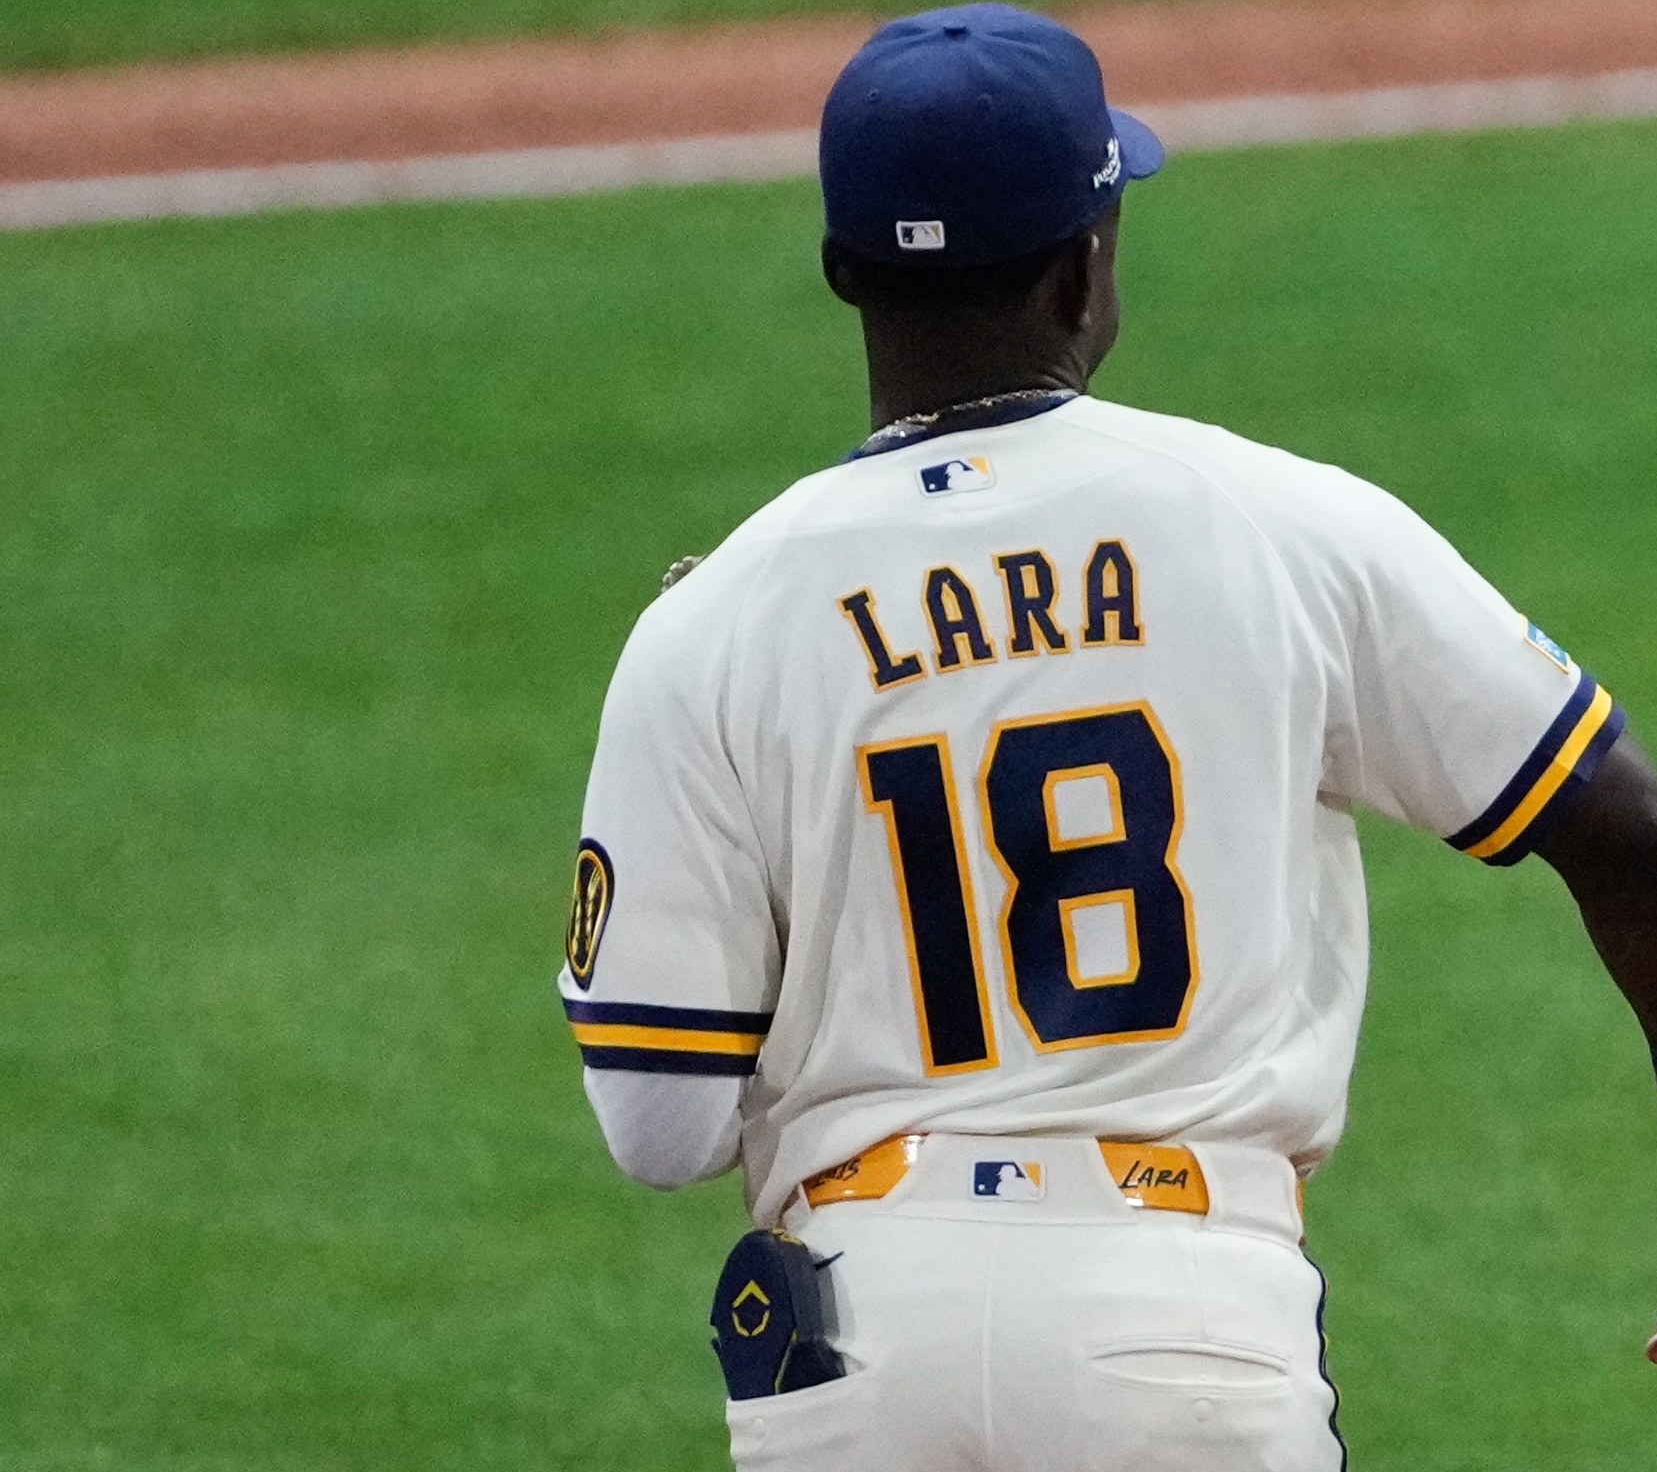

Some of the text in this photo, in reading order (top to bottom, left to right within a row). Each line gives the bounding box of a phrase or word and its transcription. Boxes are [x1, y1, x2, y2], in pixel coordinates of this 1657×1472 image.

[837, 537, 1146, 691] LARA
[854, 699, 1201, 1078] 18
[1118, 1160, 1188, 1189] LARA
